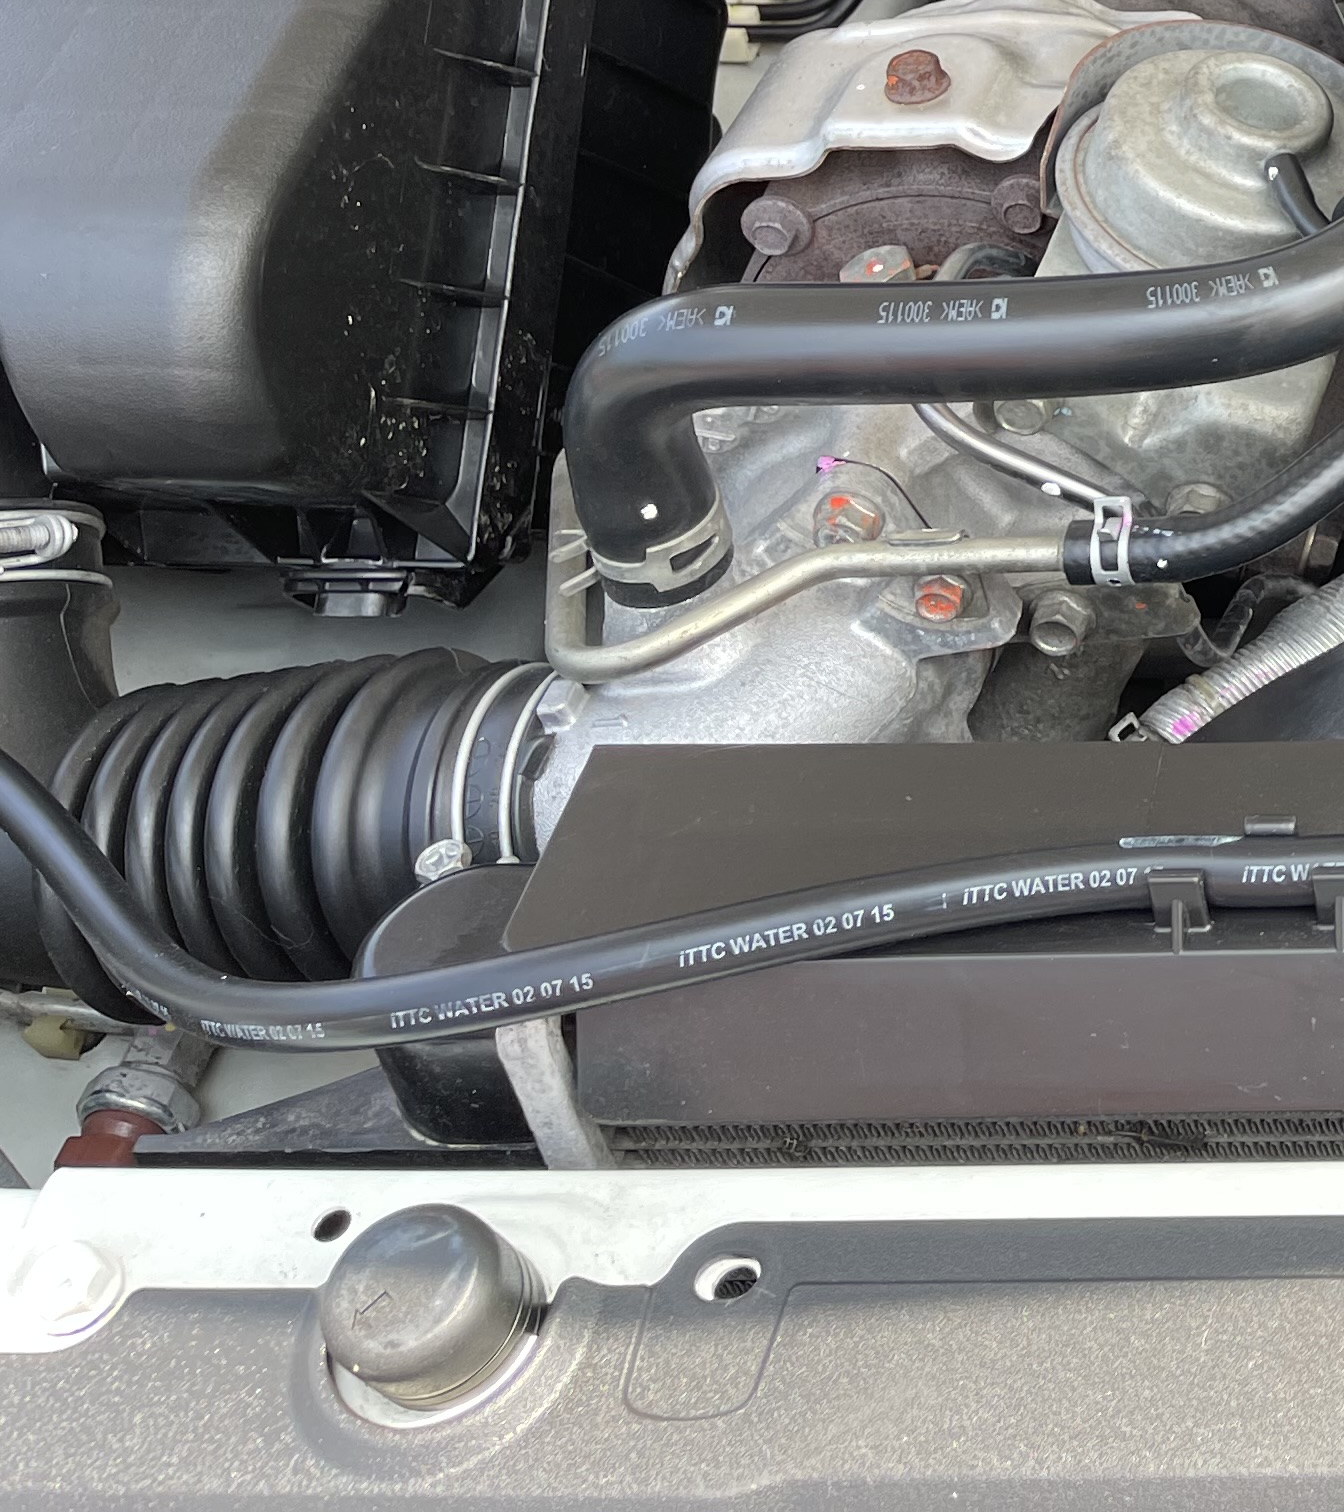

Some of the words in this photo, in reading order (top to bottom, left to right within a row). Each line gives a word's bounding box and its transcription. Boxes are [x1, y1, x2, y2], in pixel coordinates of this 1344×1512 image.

[1146, 281, 1201, 308] 300115
[877, 301, 933, 323] 300115
[598, 318, 648, 356] 300115
[1012, 874, 1085, 896] WATER
[1089, 870, 1111, 887] 02
[1115, 868, 1138, 885] 07
[729, 924, 808, 955] WATER
[813, 917, 837, 936] 02
[841, 911, 865, 930] 07
[871, 904, 895, 924] 15
[434, 992, 508, 1021] WATER
[511, 985, 537, 1006] 02
[539, 980, 564, 998] 07
[568, 973, 594, 991] 15
[227, 1024, 266, 1041] WATER
